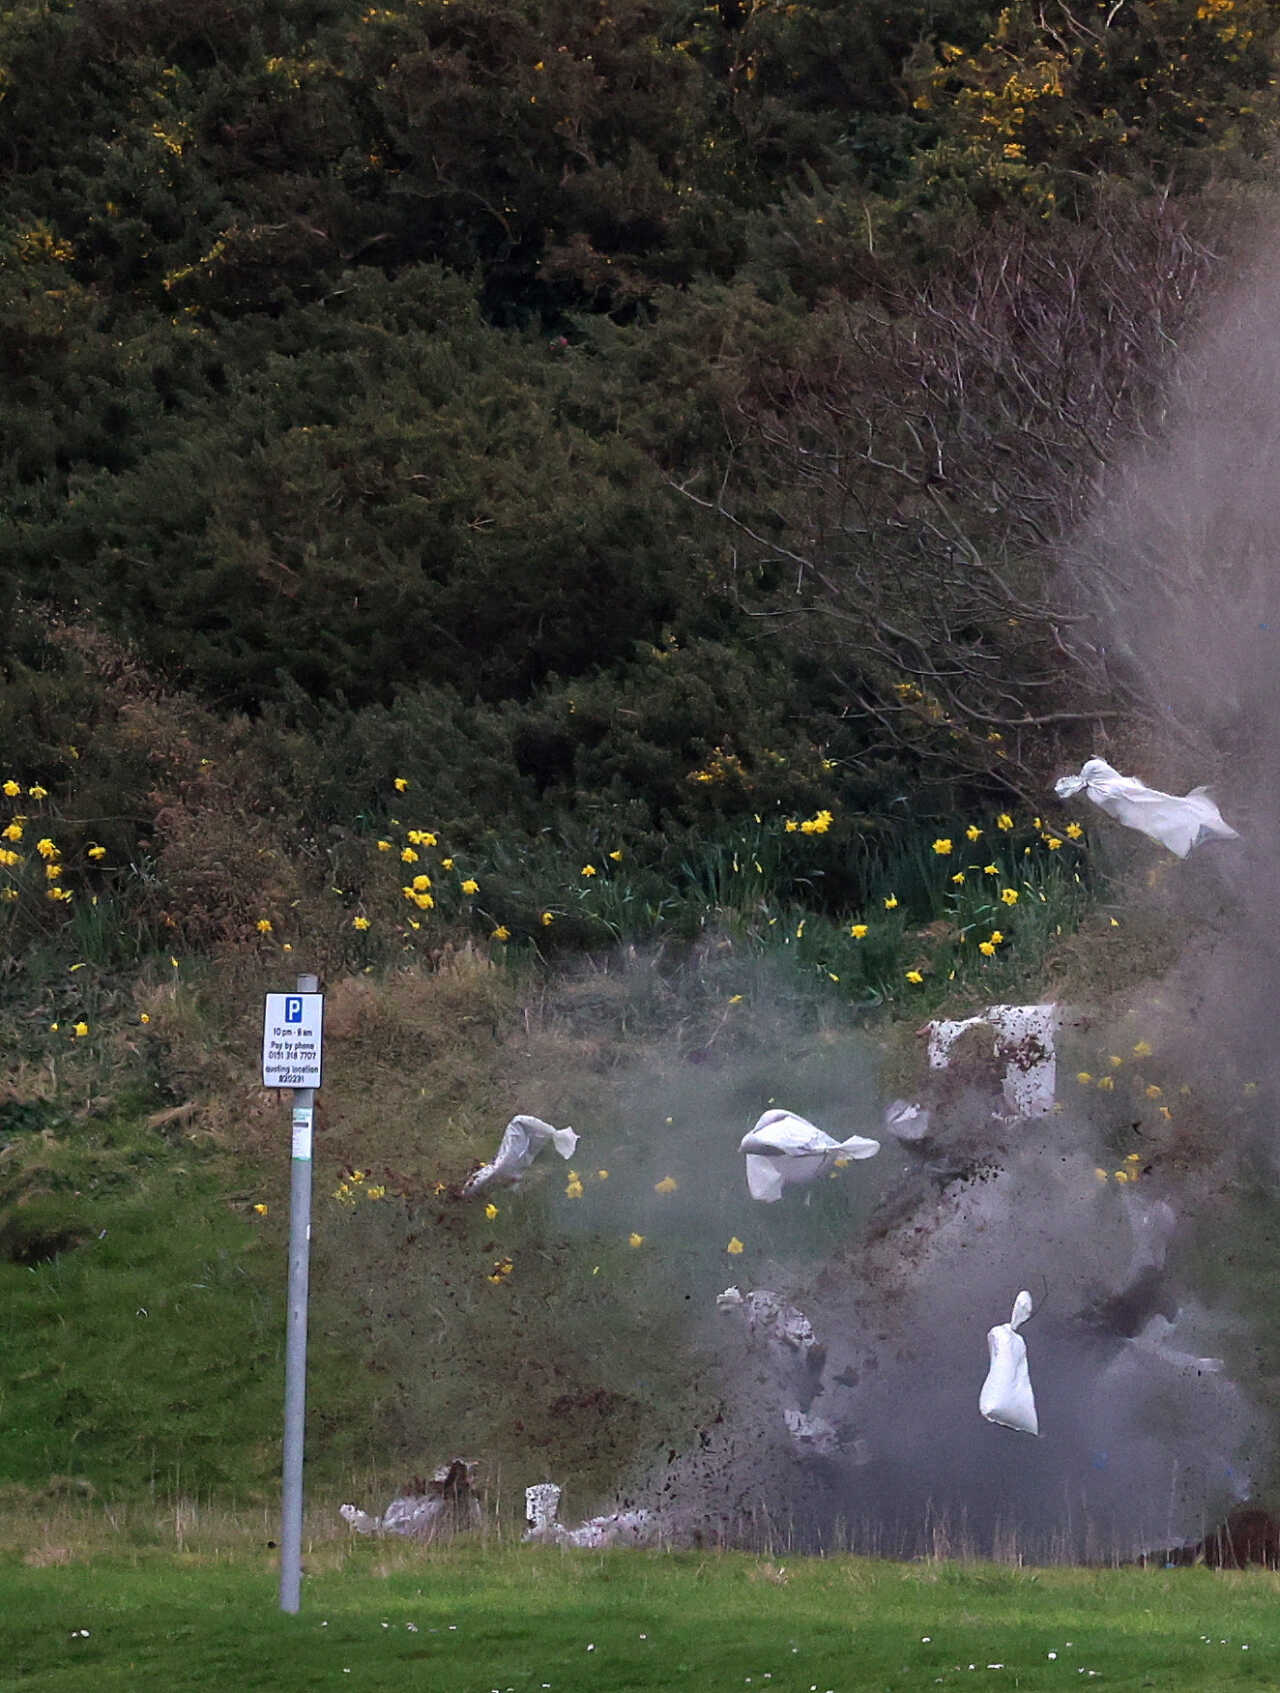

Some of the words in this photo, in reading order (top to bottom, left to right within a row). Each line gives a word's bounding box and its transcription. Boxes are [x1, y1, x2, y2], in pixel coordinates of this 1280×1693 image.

[289, 999, 300, 1020] P
[271, 1040, 282, 1051] Pay
[285, 1041, 292, 1051] by
[295, 1041, 314, 1051] phone
[265, 1065, 290, 1075] quoting
[292, 1064, 319, 1073] location
